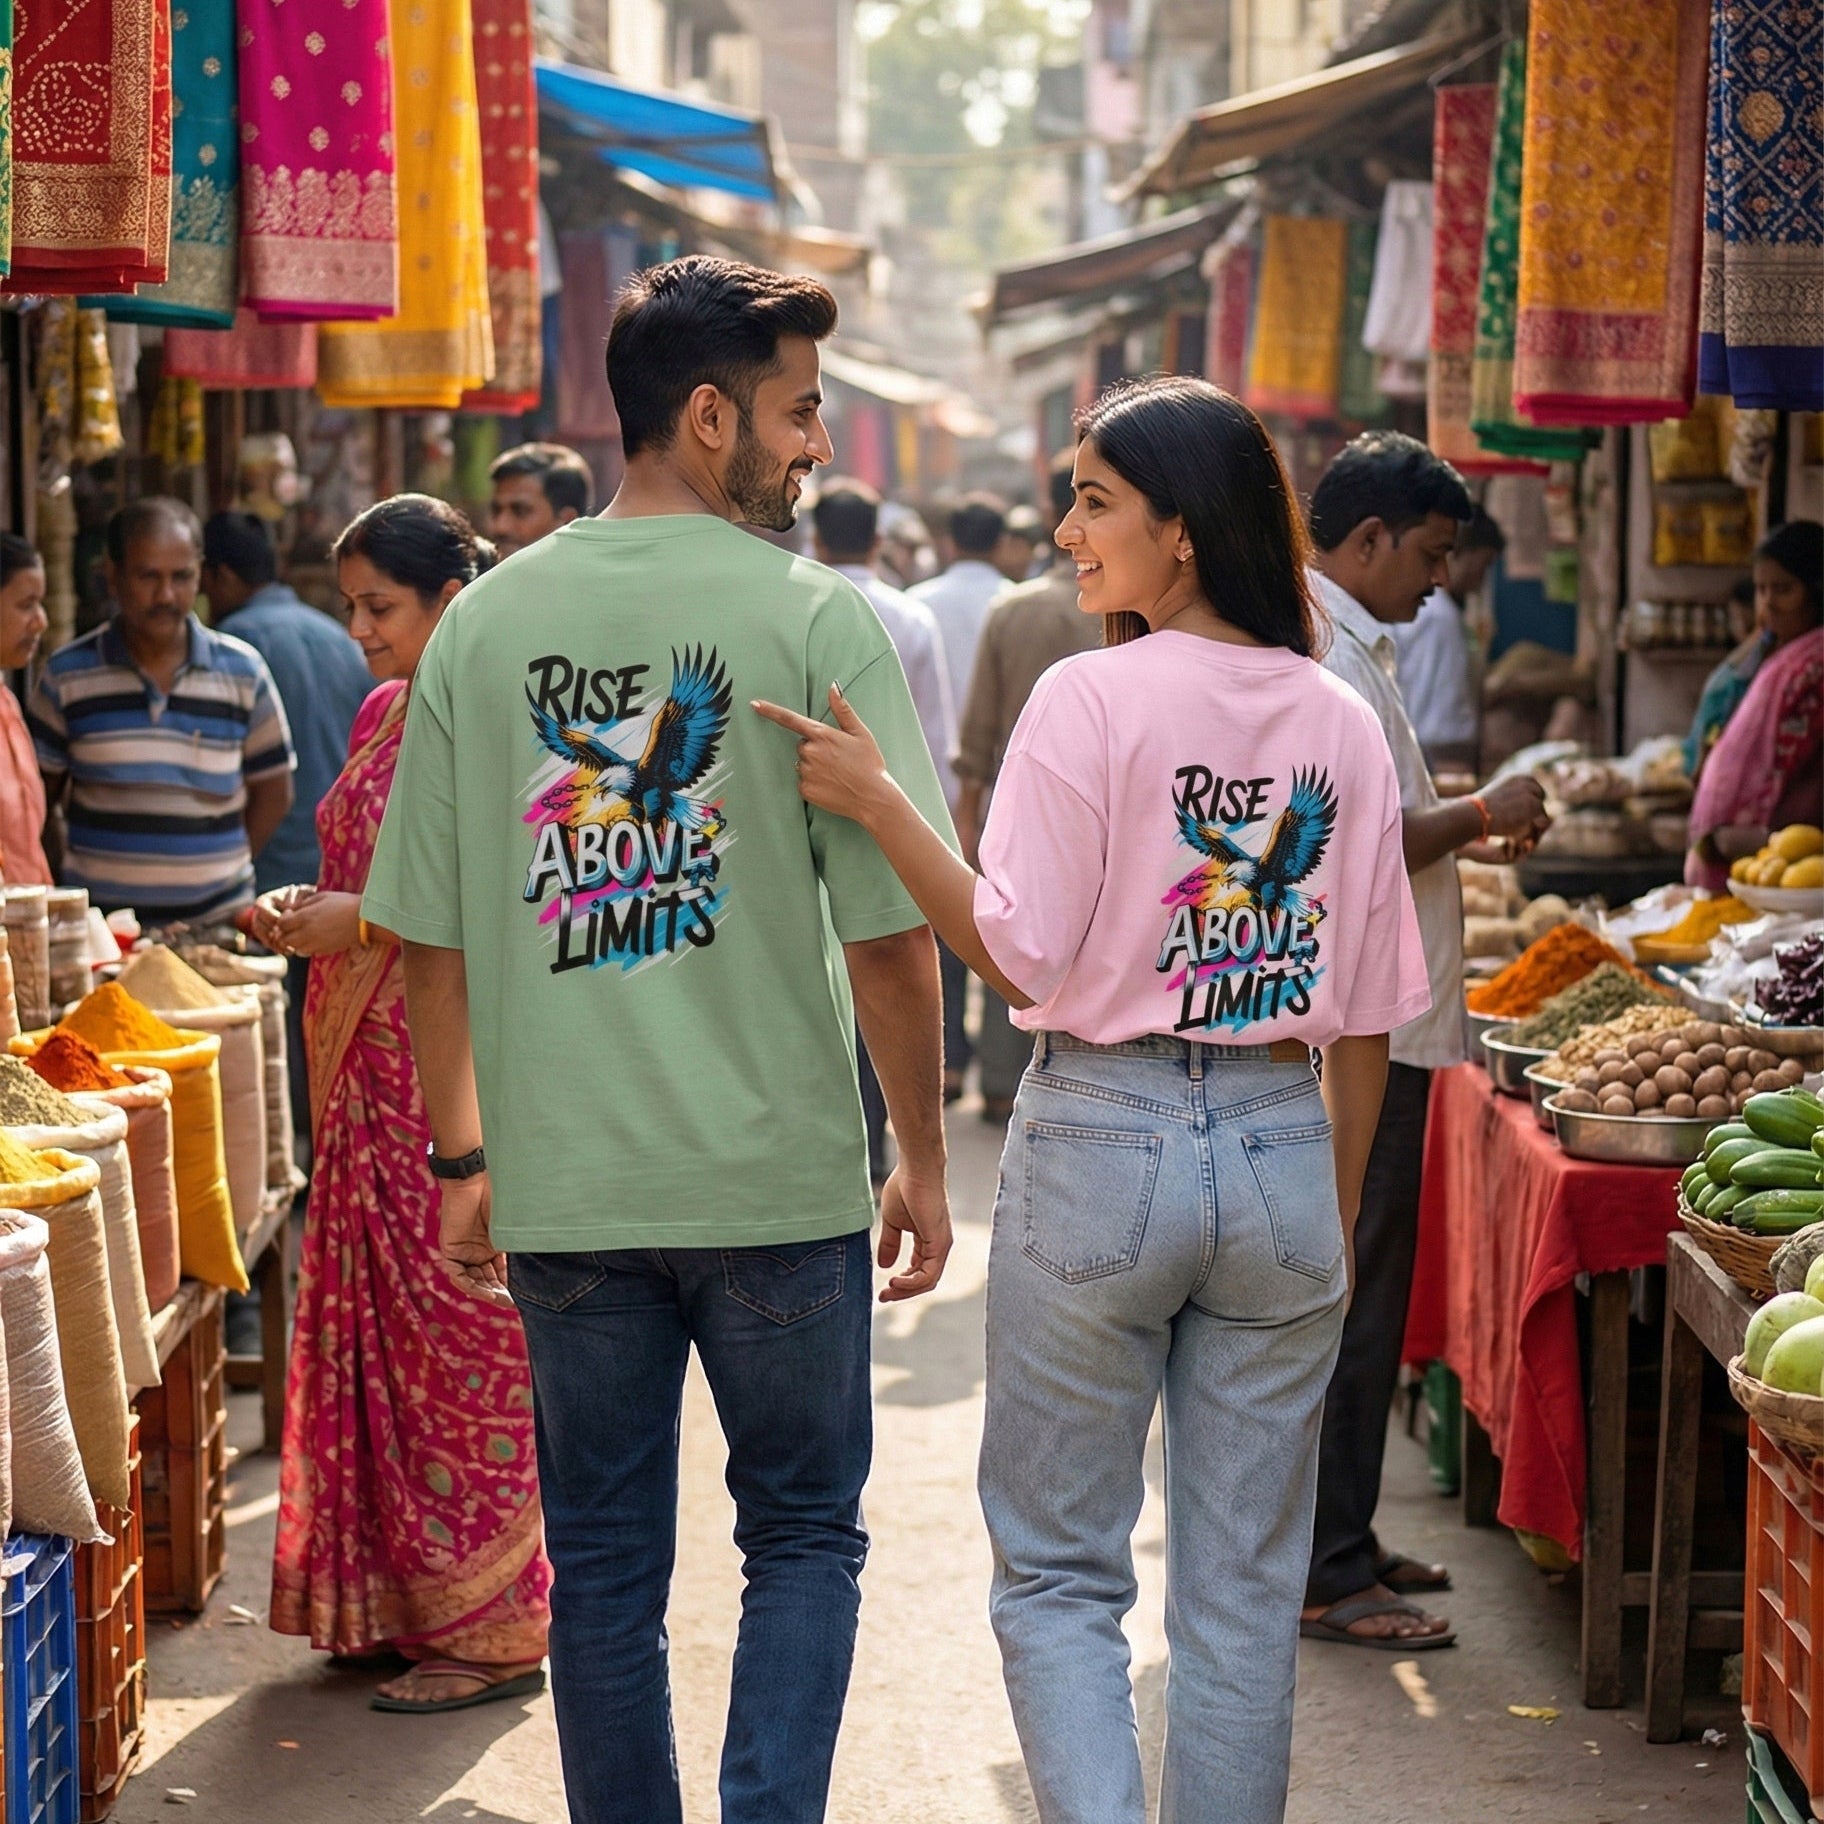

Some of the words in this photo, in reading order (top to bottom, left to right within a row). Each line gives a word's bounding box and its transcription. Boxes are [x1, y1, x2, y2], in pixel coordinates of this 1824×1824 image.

[528, 655, 651, 727] RISE
[1175, 764, 1275, 824] RISE
[523, 820, 720, 903] ABOVE
[1156, 904, 1319, 973] ABOVE
